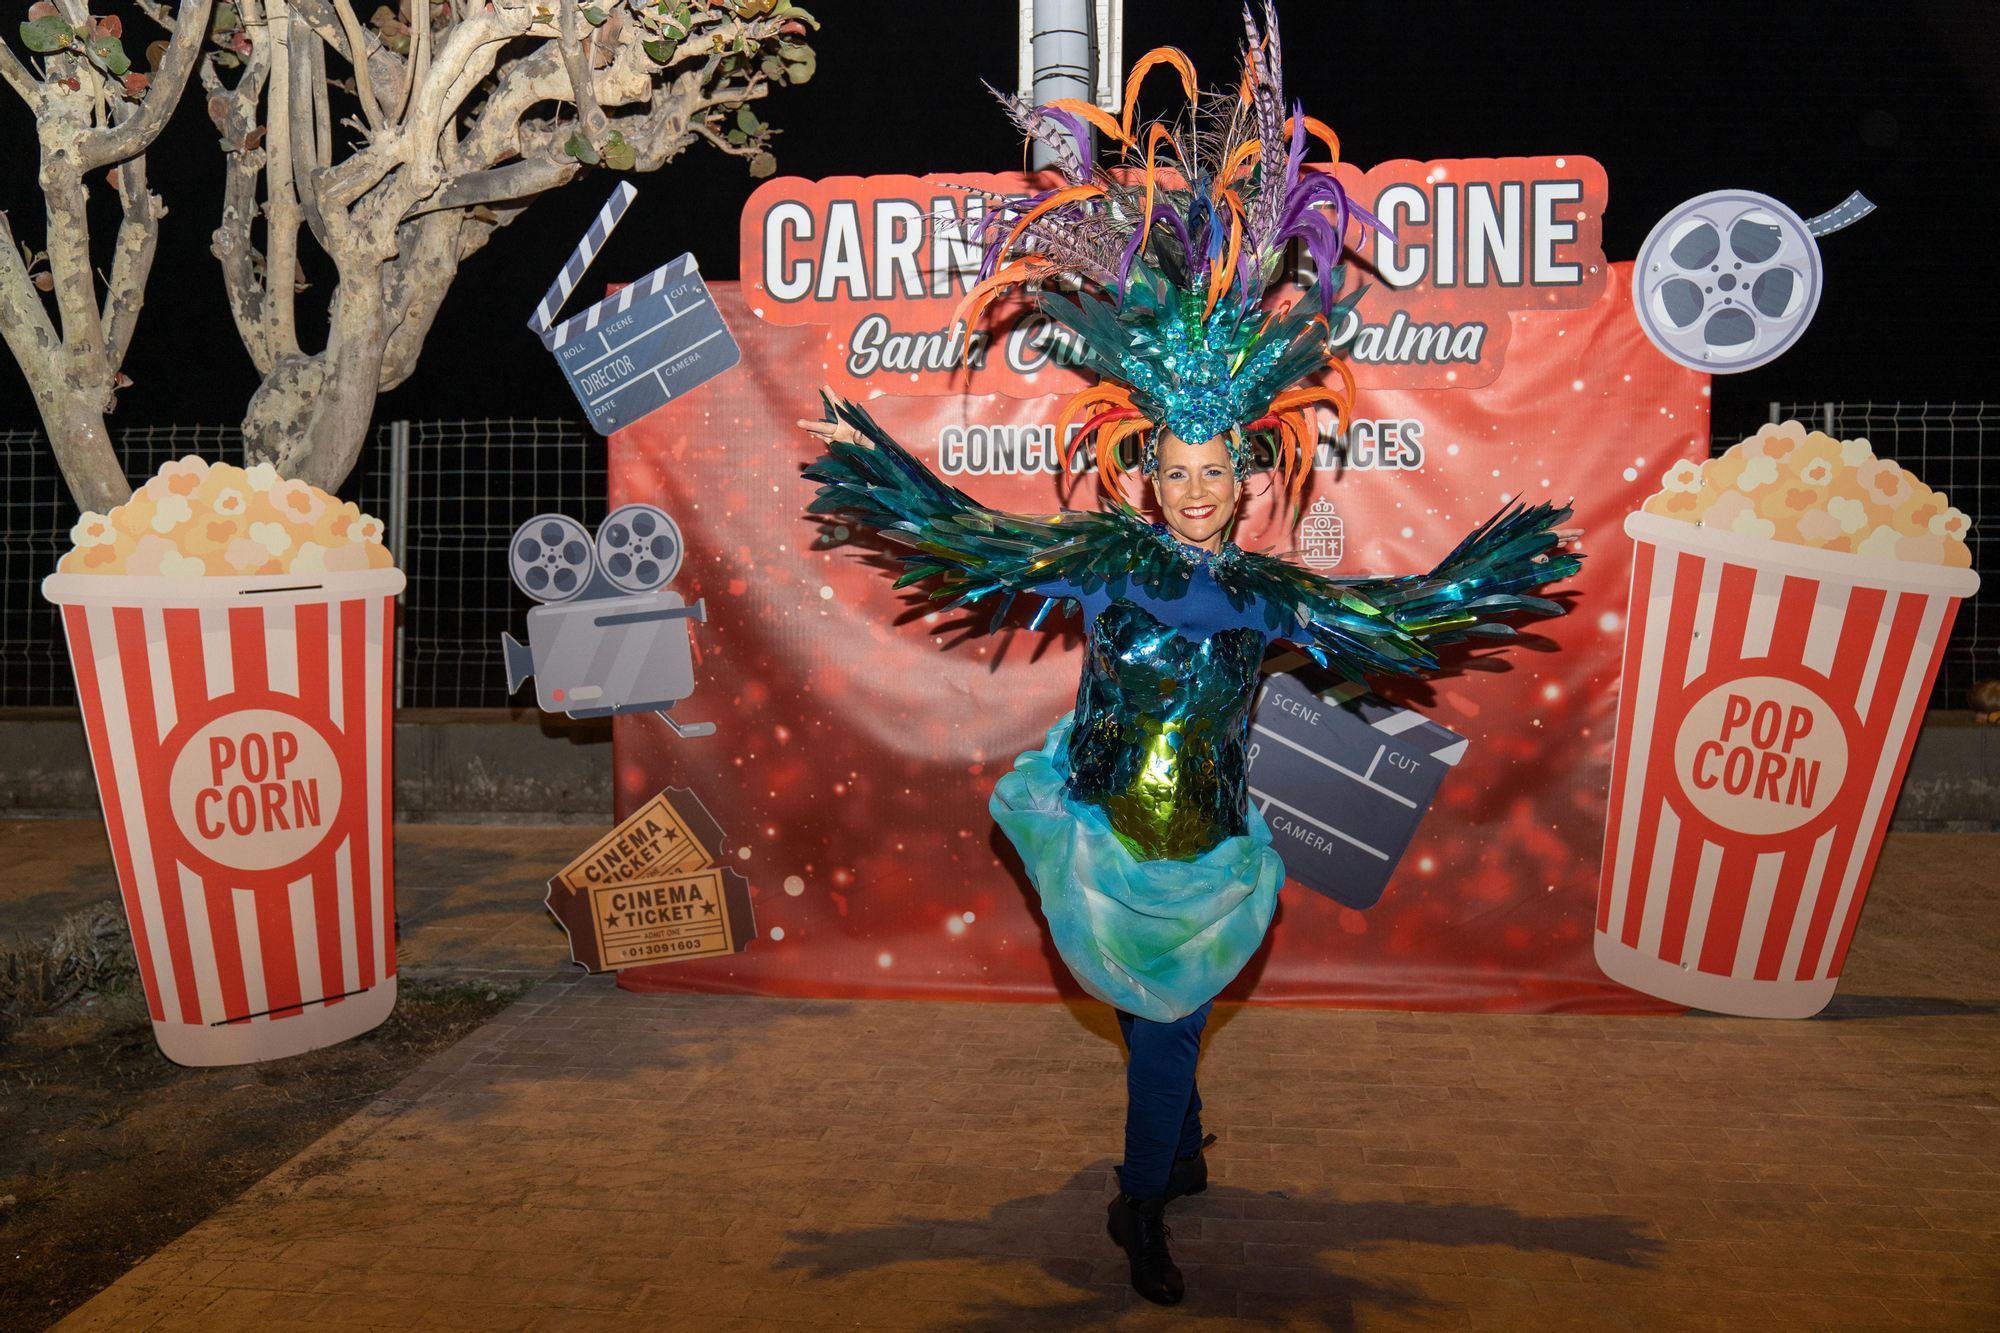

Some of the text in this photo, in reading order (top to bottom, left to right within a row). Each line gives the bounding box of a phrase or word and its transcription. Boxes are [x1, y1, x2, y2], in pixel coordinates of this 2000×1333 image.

[1376, 183, 1581, 288] CINE
[563, 284, 688, 360] ROLL SCENE CUT
[849, 310, 1483, 375] Santa Cru Palma
[580, 355, 636, 396] DIRECTOR
[594, 352, 702, 417] DATE CAMERA
[1271, 693, 1421, 774] SCENE CUT
[1719, 693, 1814, 754] POP
[209, 731, 298, 787] POP
[1692, 740, 1822, 809] CORN
[195, 778, 321, 840] CORN
[1272, 816, 1334, 855] CAMERA
[584, 819, 662, 883] CINEMA
[612, 884, 703, 912] CINEMA
[625, 904, 694, 927] TICKET
[629, 939, 702, 957] 013091603
[644, 928, 681, 940] ADMIT ONE
